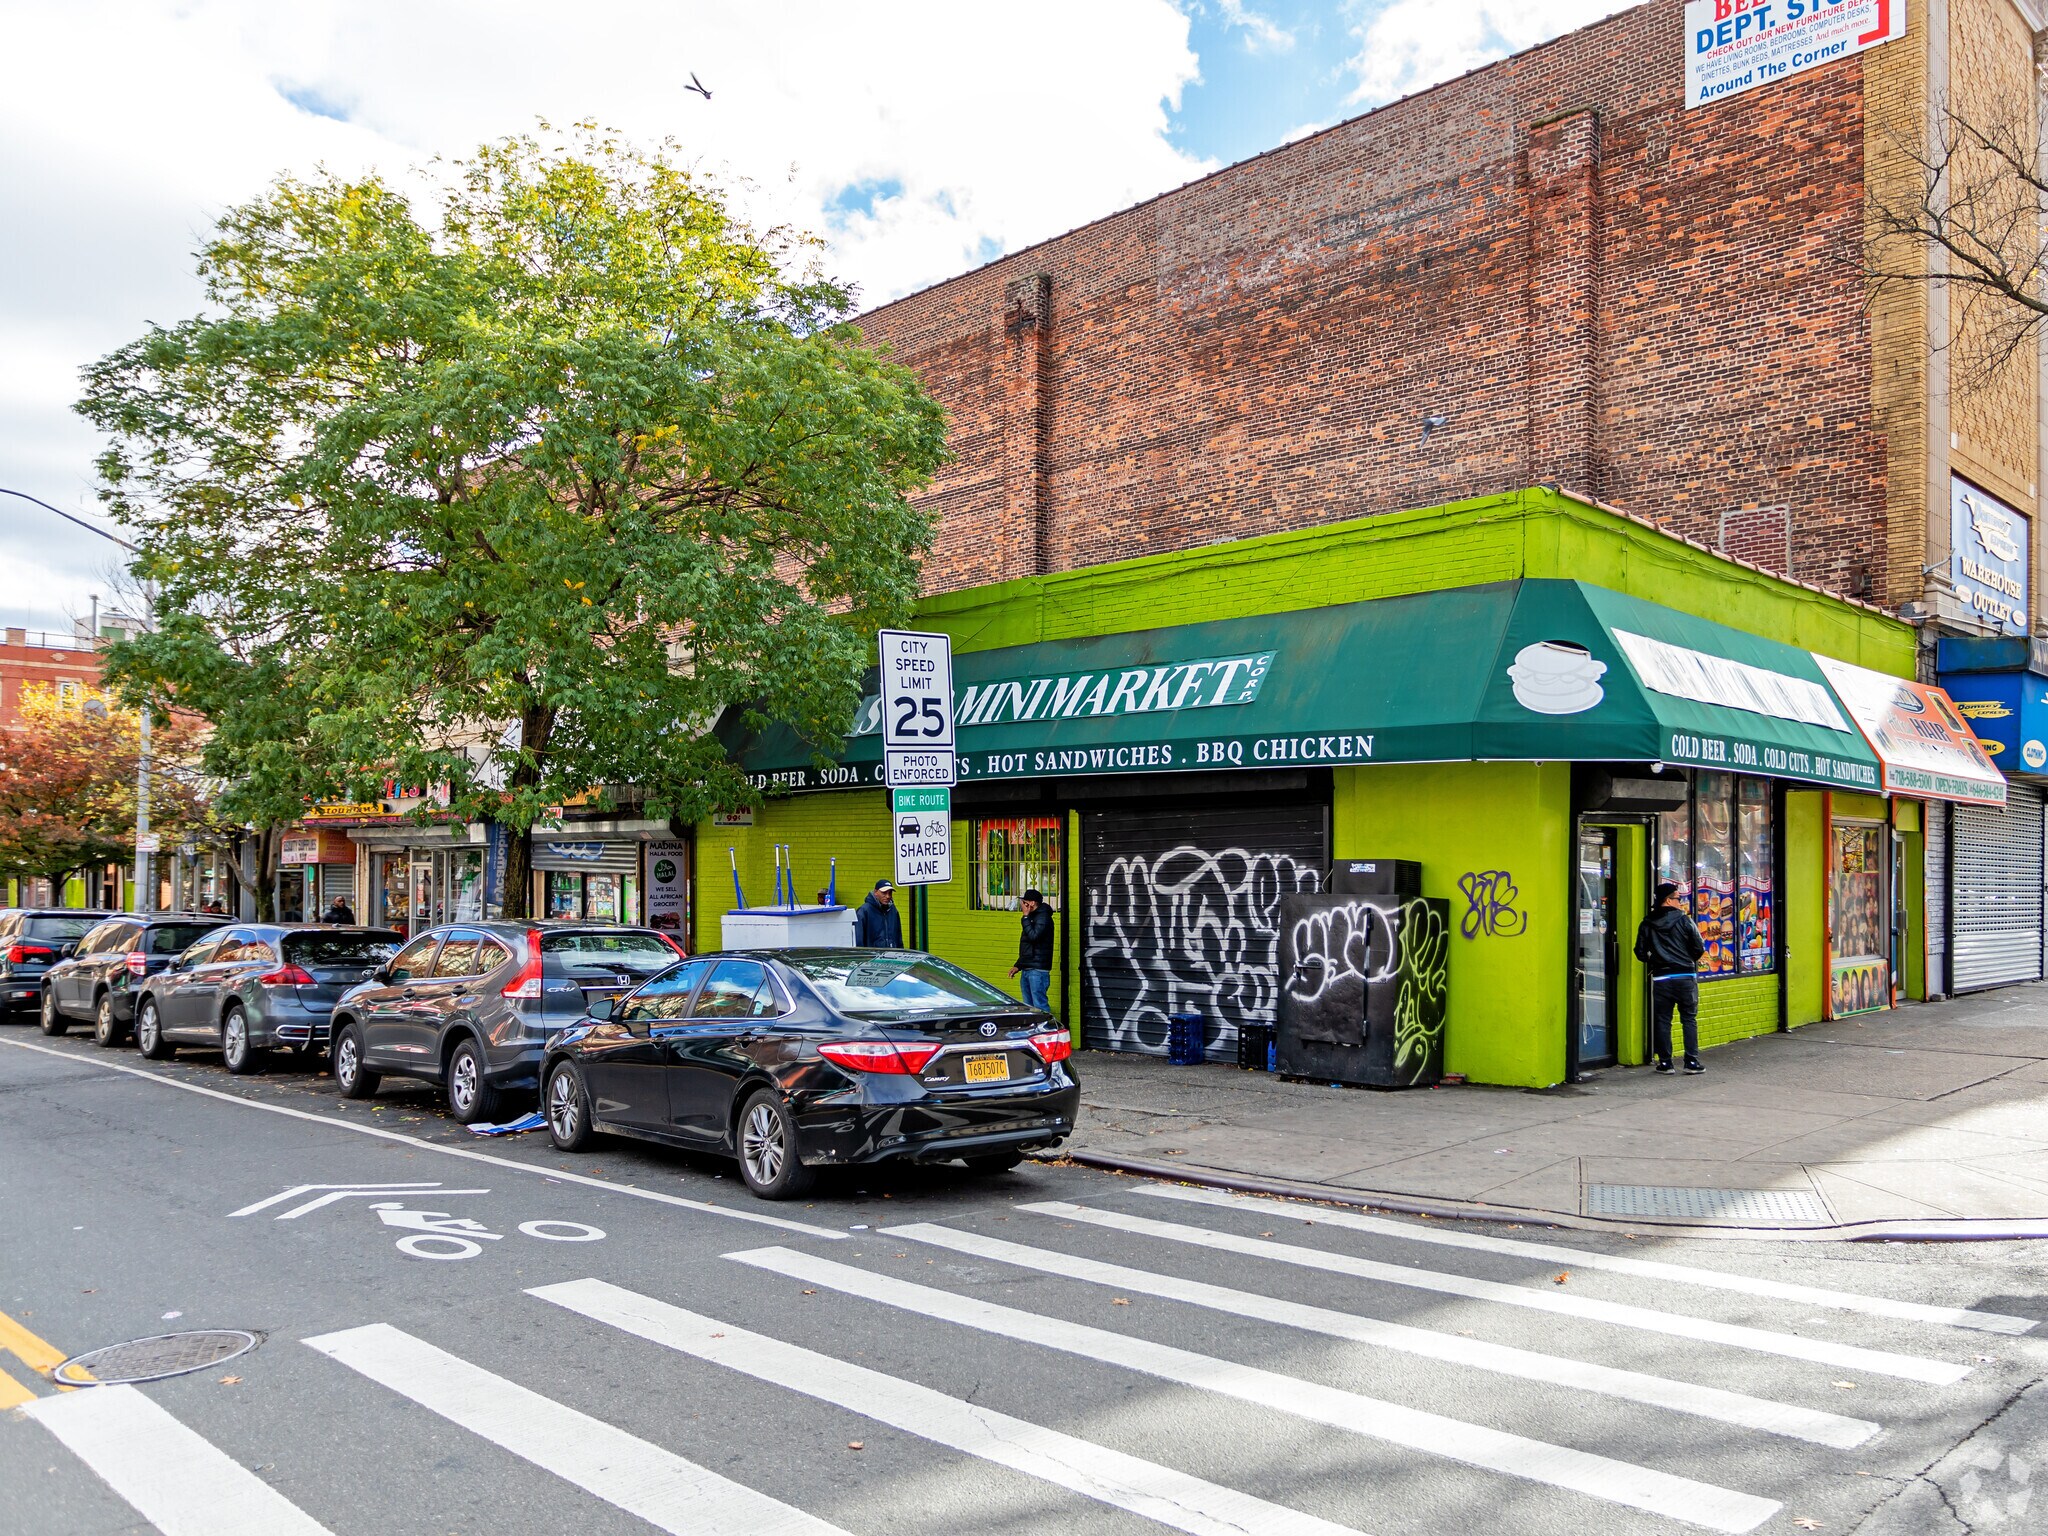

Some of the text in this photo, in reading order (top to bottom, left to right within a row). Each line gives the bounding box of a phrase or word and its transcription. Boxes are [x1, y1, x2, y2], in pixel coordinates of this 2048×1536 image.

[1697, 4, 1776, 54] DEPT.
[1706, 44, 1734, 59] CHECK
[1736, 36, 1753, 49] OUT
[1755, 29, 1773, 42] OUR
[1775, 22, 1794, 35] NEW
[1796, 5, 1845, 28] FURNITURE
[1695, 64, 1705, 73] WE
[1706, 59, 1722, 70] HAVE
[1723, 51, 1743, 63] LIVING
[1809, 14, 1845, 33] COMPUTER
[1732, 58, 1750, 71] BUNK
[1771, 36, 1813, 56] MATTRESSES
[1815, 30, 1830, 41] And
[1830, 22, 1850, 35] much
[1699, 40, 1847, 100] Around The Corner
[1960, 556, 2022, 600] WAREHOUSE
[1973, 591, 2012, 622] OUTLET
[901, 641, 928, 654] CITY
[895, 659, 935, 672] SPEED
[901, 677, 932, 690] LIMIT
[1957, 703, 1999, 711] Domsey
[893, 696, 945, 737] 25
[1908, 717, 1952, 743] HAIR
[820, 766, 859, 785] SODA
[987, 753, 1027, 774] HOT
[1034, 744, 1173, 771] SANDWICHES
[1196, 740, 1243, 765] BBQ
[1253, 735, 1374, 761] CHICKEN
[903, 756, 938, 766] PHOTO
[1671, 734, 1699, 758] COLD
[1701, 738, 1726, 762] BEER
[1733, 743, 1757, 766] SODA
[1764, 747, 1787, 770] COLD
[1788, 751, 1809, 774] CUTS
[1815, 756, 1831, 778] HOT
[1832, 759, 1875, 785] SANDWICHES
[893, 768, 949, 779] ENFORCED
[898, 794, 945, 807] BIKE ROUTE
[649, 842, 683, 850] MADINA
[900, 842, 946, 858] SHARED
[656, 871, 675, 879] HALAL
[908, 861, 939, 876] LANE
[968, 1061, 1005, 1077] T687507C
